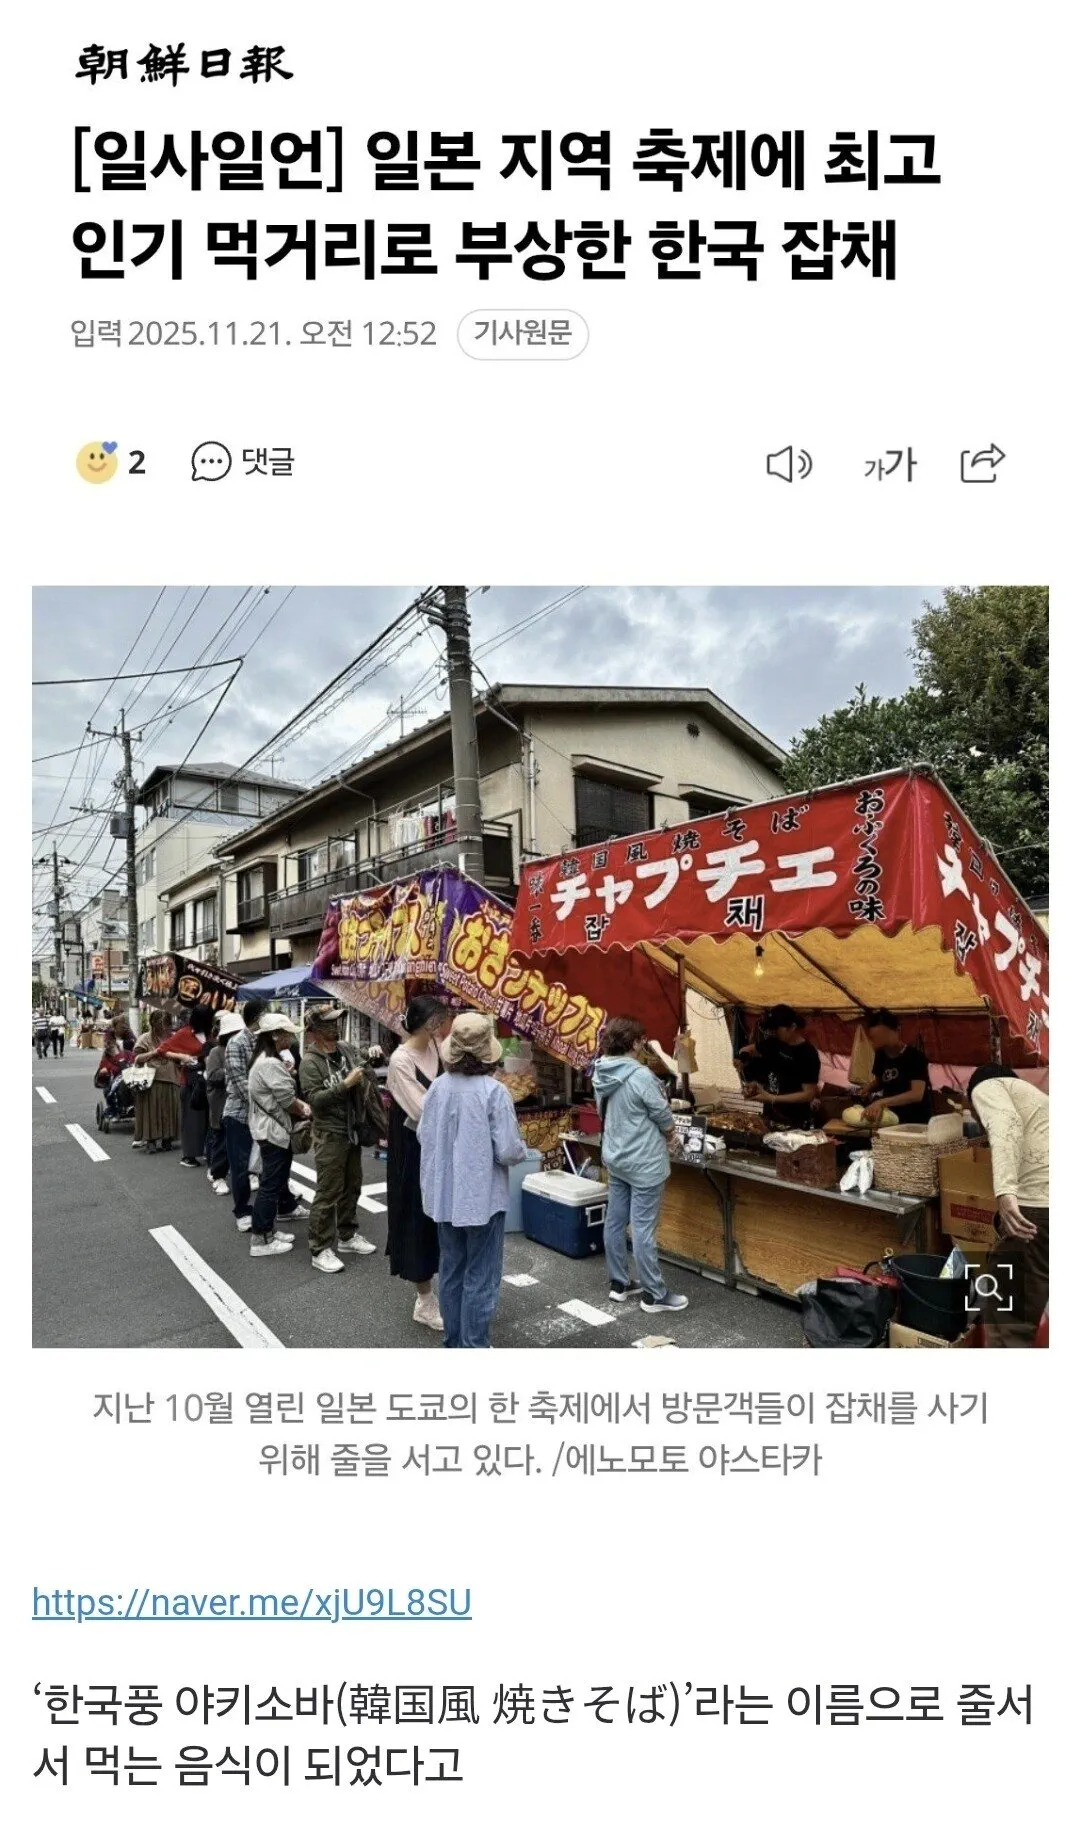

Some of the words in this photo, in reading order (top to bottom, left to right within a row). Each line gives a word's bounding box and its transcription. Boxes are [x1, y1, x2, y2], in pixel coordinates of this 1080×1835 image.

[848, 788, 887, 924] おふくろの味
